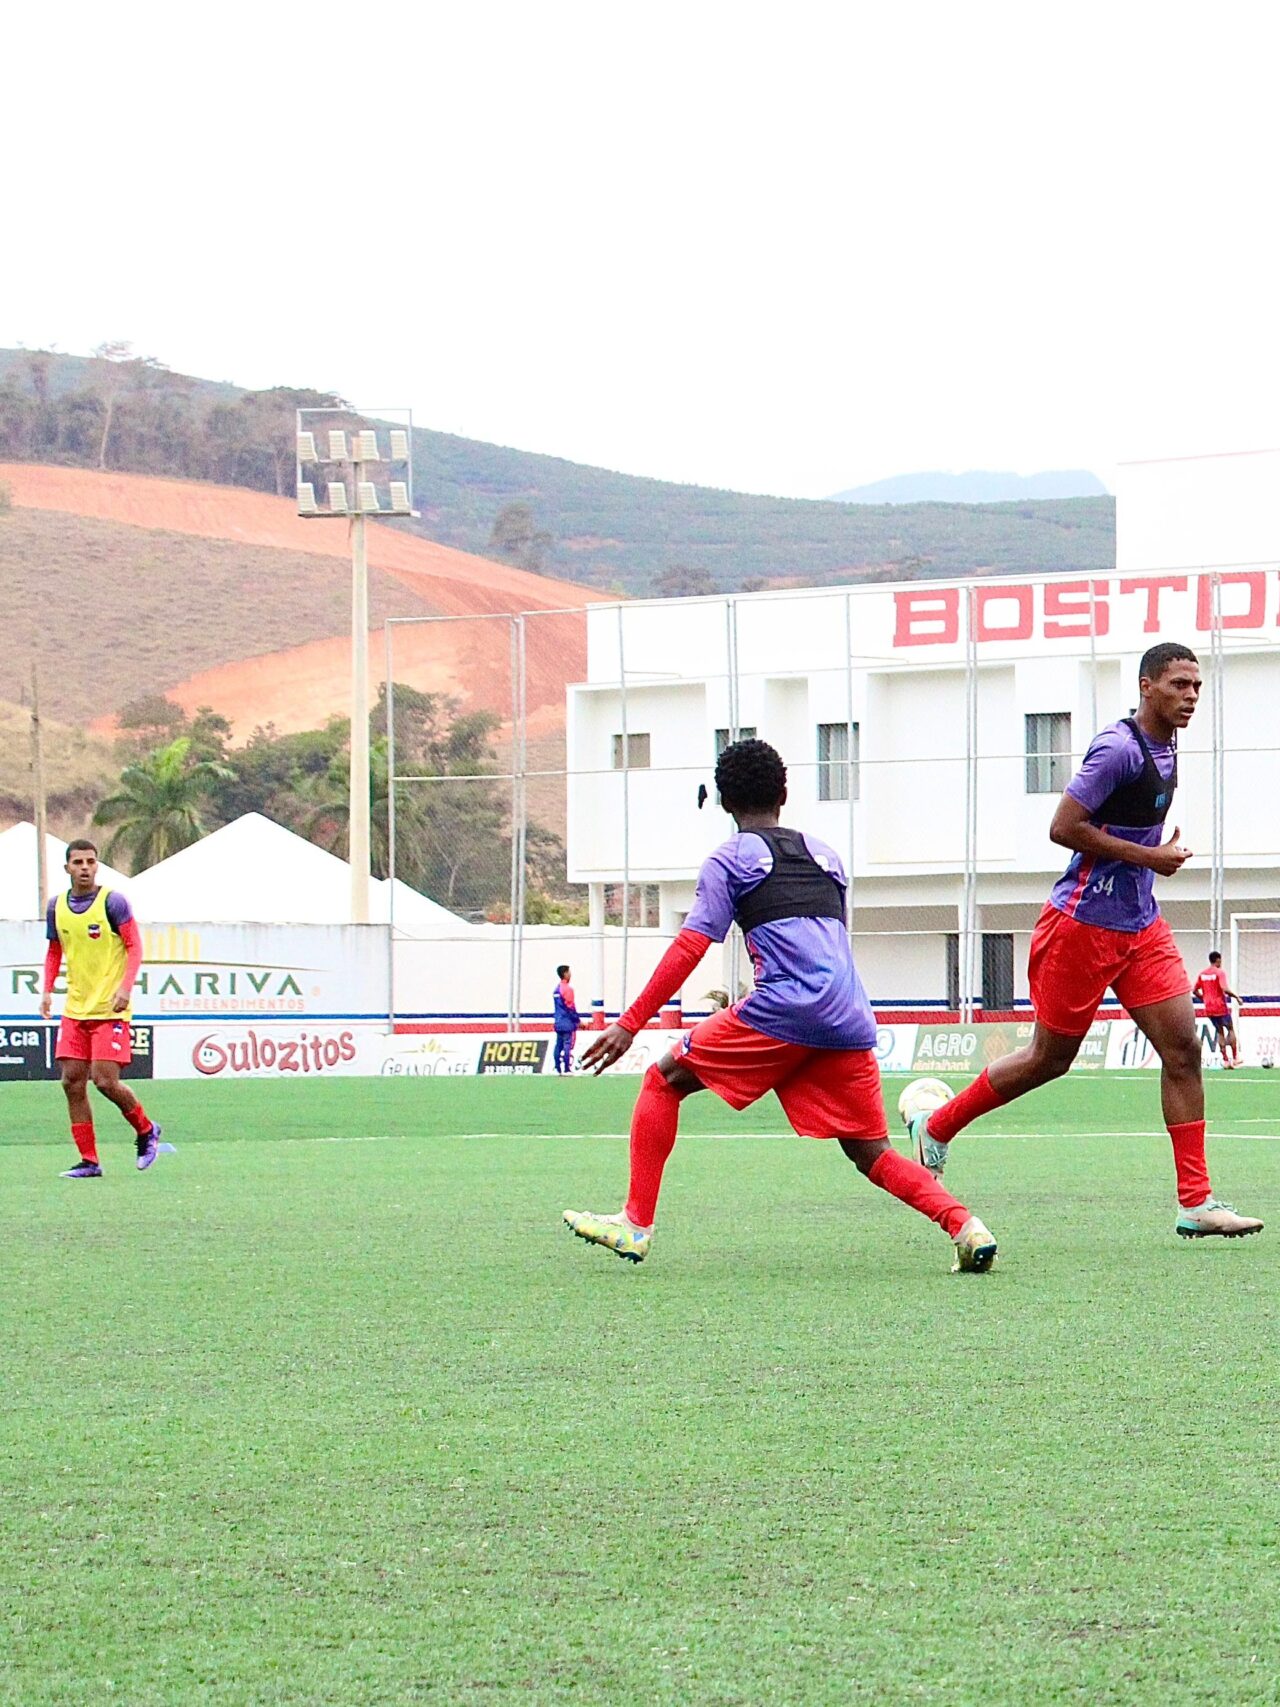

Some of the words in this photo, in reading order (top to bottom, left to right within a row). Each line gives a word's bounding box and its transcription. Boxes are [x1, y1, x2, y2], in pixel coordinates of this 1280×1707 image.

[1093, 875, 1114, 896] 34
[12, 970, 303, 995] RHARIVA
[159, 999, 305, 1010] EMPREENDIMENTOS
[192, 1030, 357, 1075] Gulozitos
[483, 1042, 540, 1063] HOTEL
[917, 1033, 977, 1057] AGRO
